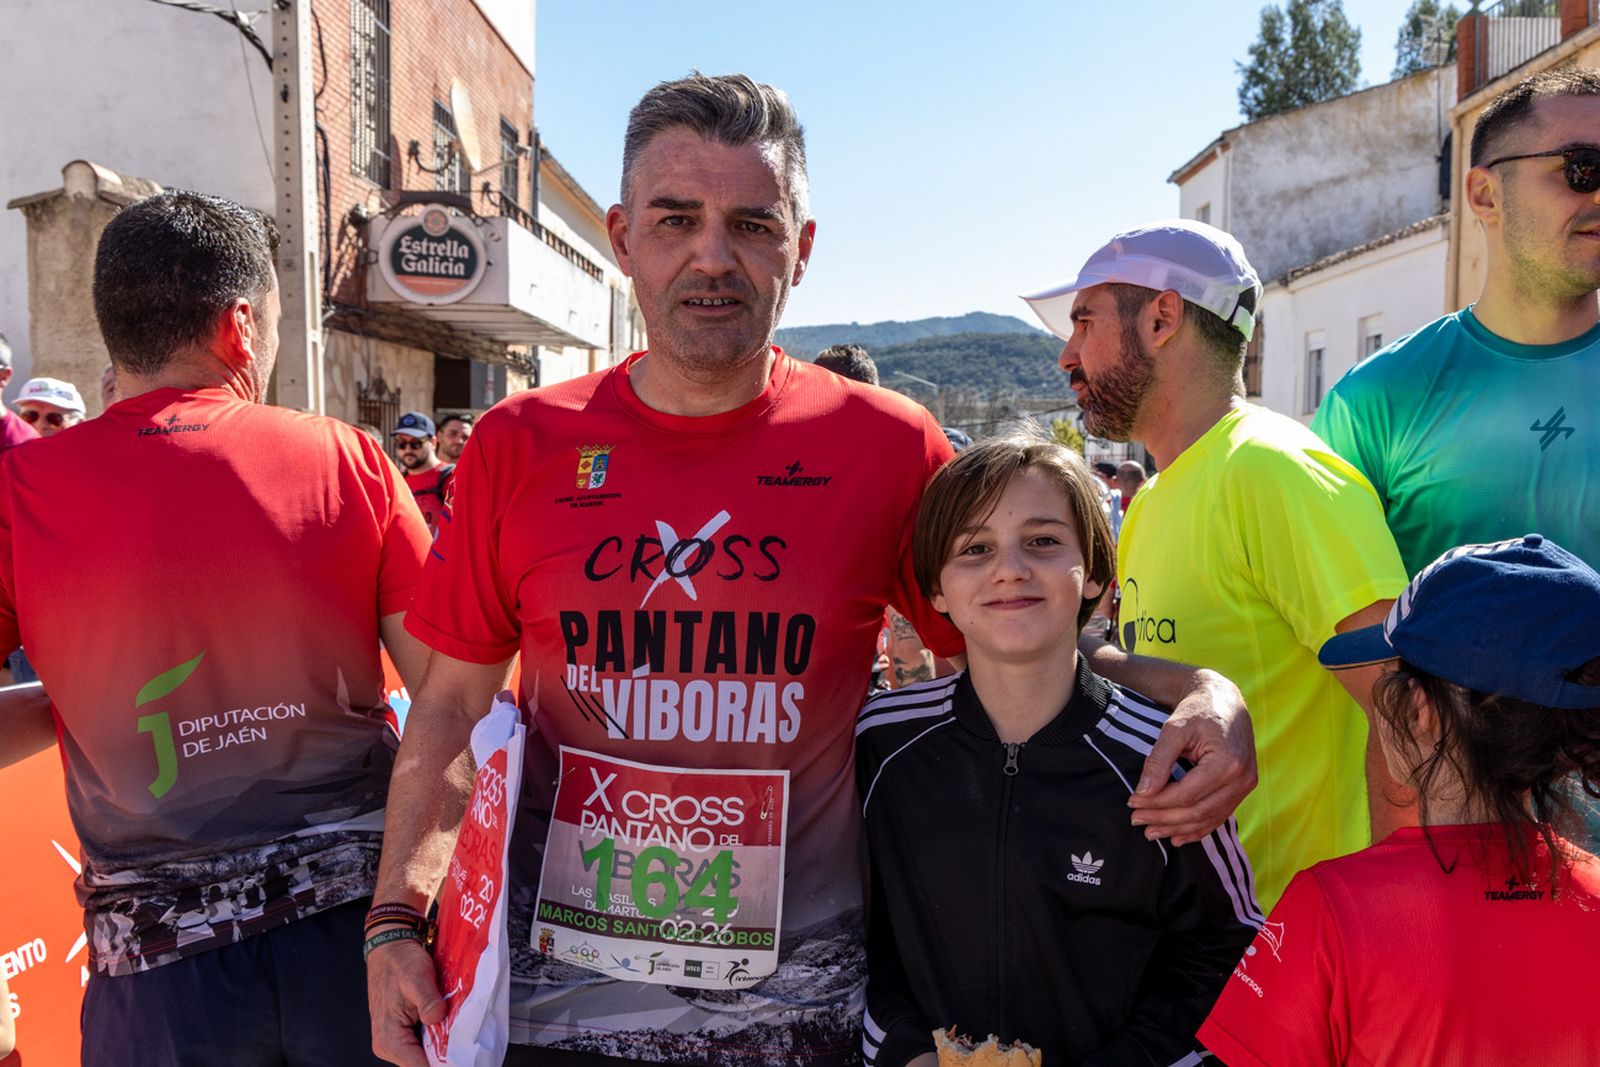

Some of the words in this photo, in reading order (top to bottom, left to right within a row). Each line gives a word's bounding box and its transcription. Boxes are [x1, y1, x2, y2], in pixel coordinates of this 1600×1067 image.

[399, 236, 469, 259] Estrella
[401, 254, 465, 276] Galicia
[137, 423, 210, 437] TEAMERGY
[757, 475, 832, 487] TEAMERGY
[584, 534, 787, 582] CROSS
[560, 610, 816, 675] PANTANO
[567, 664, 601, 692] DEL
[601, 664, 804, 744] VÍBORAS
[178, 703, 306, 737] DIPUTACIÓN
[182, 737, 212, 758] DE
[215, 727, 267, 750] JAÉN
[583, 766, 618, 813] X
[621, 789, 745, 826] CROSS
[579, 809, 715, 853] PANTANO
[719, 834, 744, 846] DEL
[571, 885, 592, 898] LAS
[583, 837, 739, 926] 164
[1066, 873, 1101, 886] adidas
[1484, 891, 1544, 901] TEAMERGY
[539, 902, 608, 931] MARCOS
